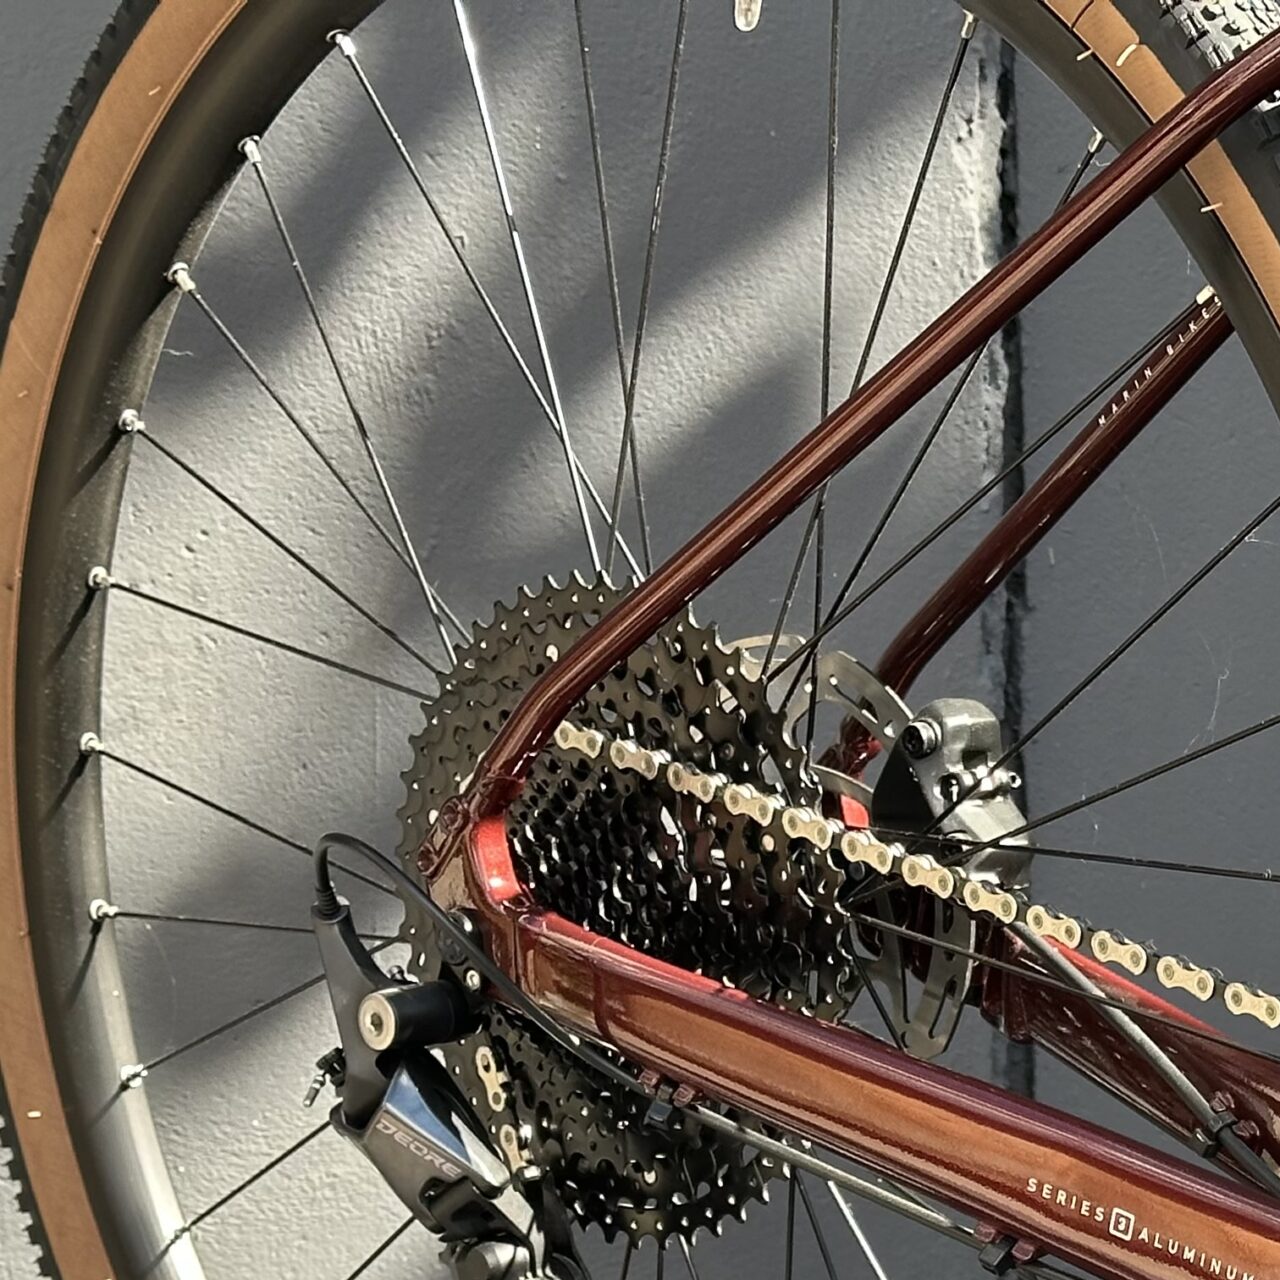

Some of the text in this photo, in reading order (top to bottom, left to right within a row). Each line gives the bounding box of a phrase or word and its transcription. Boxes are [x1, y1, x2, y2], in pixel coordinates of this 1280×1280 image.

[1098, 295, 1222, 427] MARIN BIKES
[376, 1118, 462, 1178] DEORE
[1027, 1178, 1105, 1223] SERIES
